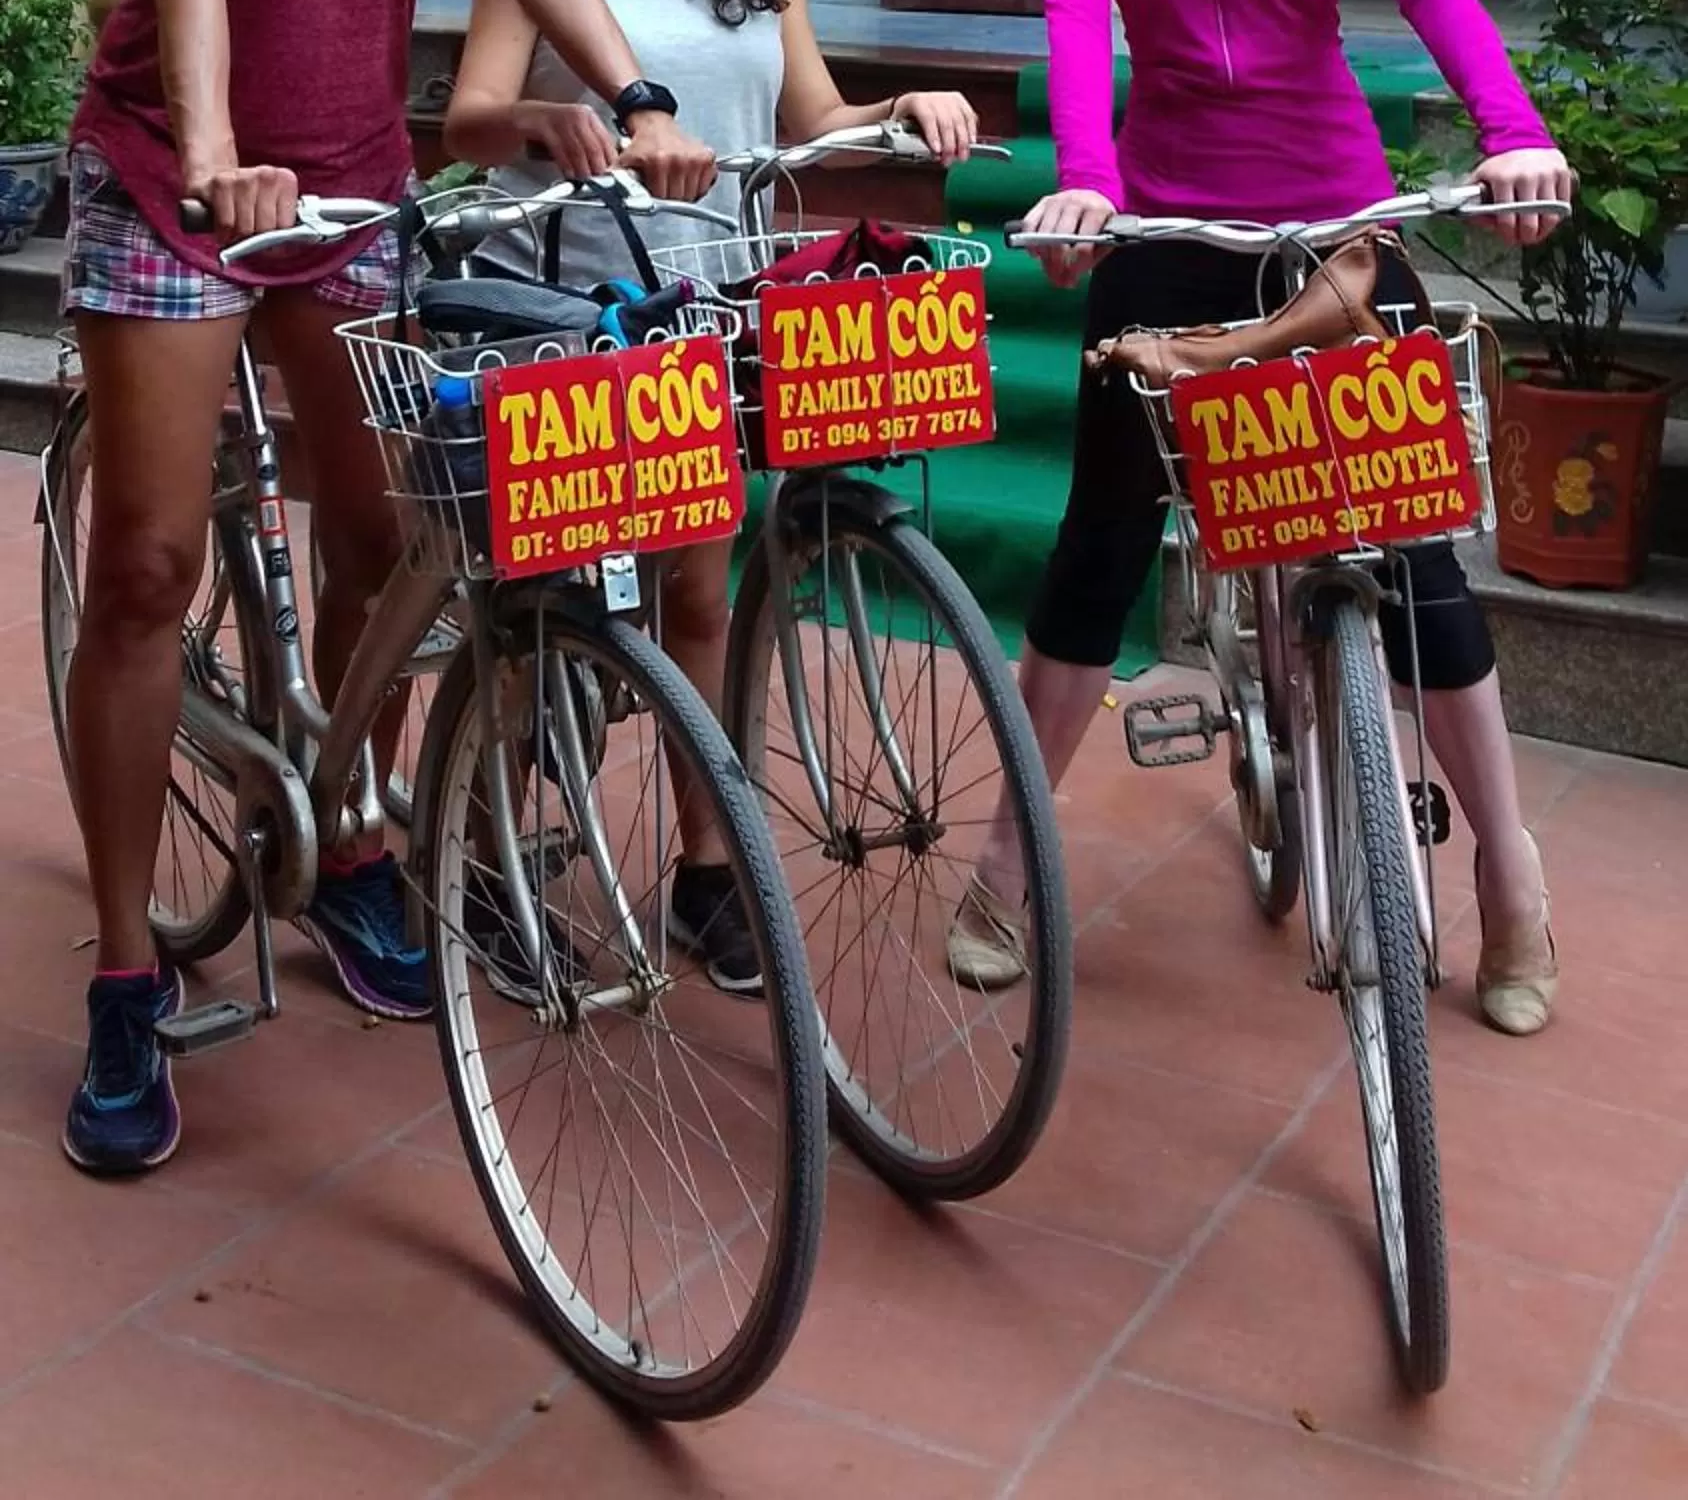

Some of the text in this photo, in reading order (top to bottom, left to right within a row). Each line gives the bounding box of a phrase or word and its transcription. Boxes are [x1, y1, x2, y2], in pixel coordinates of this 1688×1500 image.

[774, 271, 977, 370] TAM CỐC
[500, 340, 722, 465] TAM CỐC
[779, 363, 981, 419] FAMILY HOTEL
[828, 422, 870, 447] 094
[878, 416, 919, 441] 367
[928, 408, 982, 435] 7874
[1191, 339, 1447, 464] TAM CỐC
[508, 445, 729, 523] FAMILY HOTEL
[1209, 459, 1336, 517] FAMILY
[1345, 439, 1459, 495] HOTEL
[1274, 514, 1327, 545] 094
[1336, 503, 1385, 532] 367
[1395, 488, 1465, 523] 7874
[562, 522, 609, 552] 094
[618, 510, 664, 541] 367
[672, 496, 733, 531] 7874
